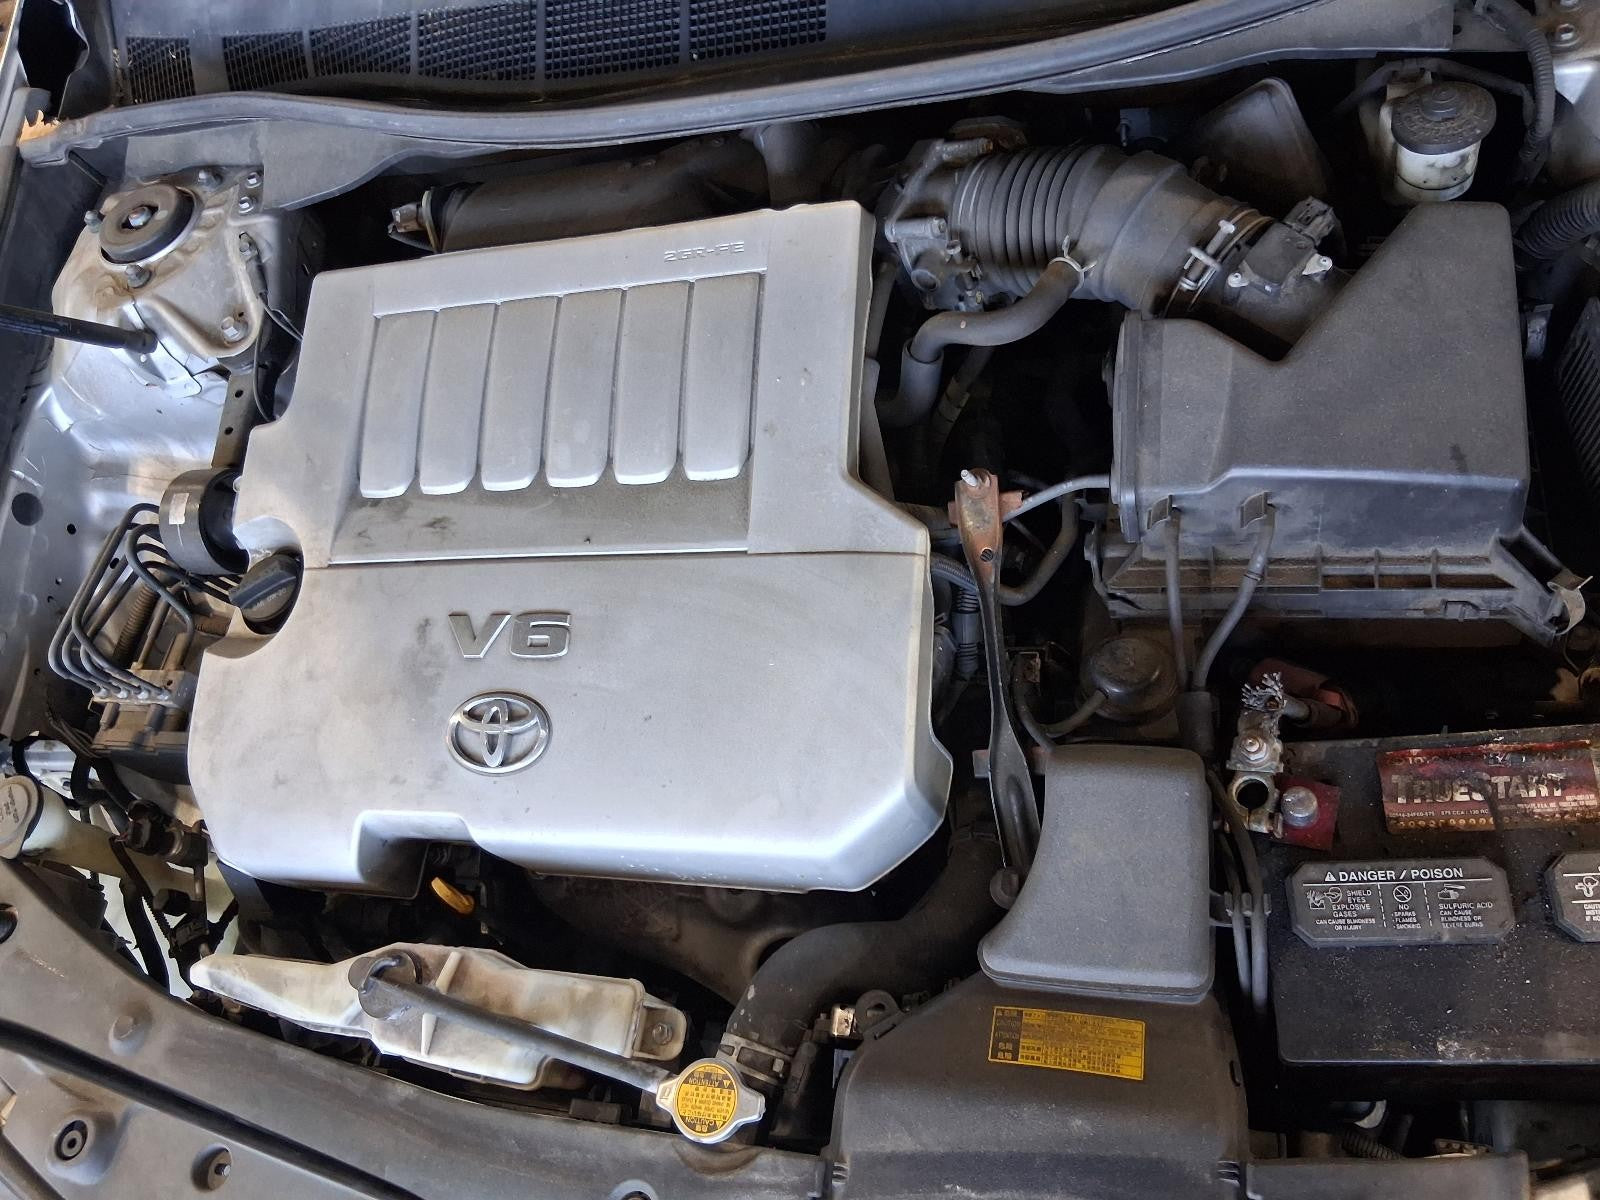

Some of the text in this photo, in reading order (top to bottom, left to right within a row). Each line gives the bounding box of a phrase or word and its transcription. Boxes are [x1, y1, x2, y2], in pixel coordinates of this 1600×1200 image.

[447, 610, 572, 659] V6
[1338, 867, 1464, 882] DANGER / POISON
[1346, 889, 1372, 897] SHIELD
[1438, 901, 1493, 910] SULFURIC ACID
